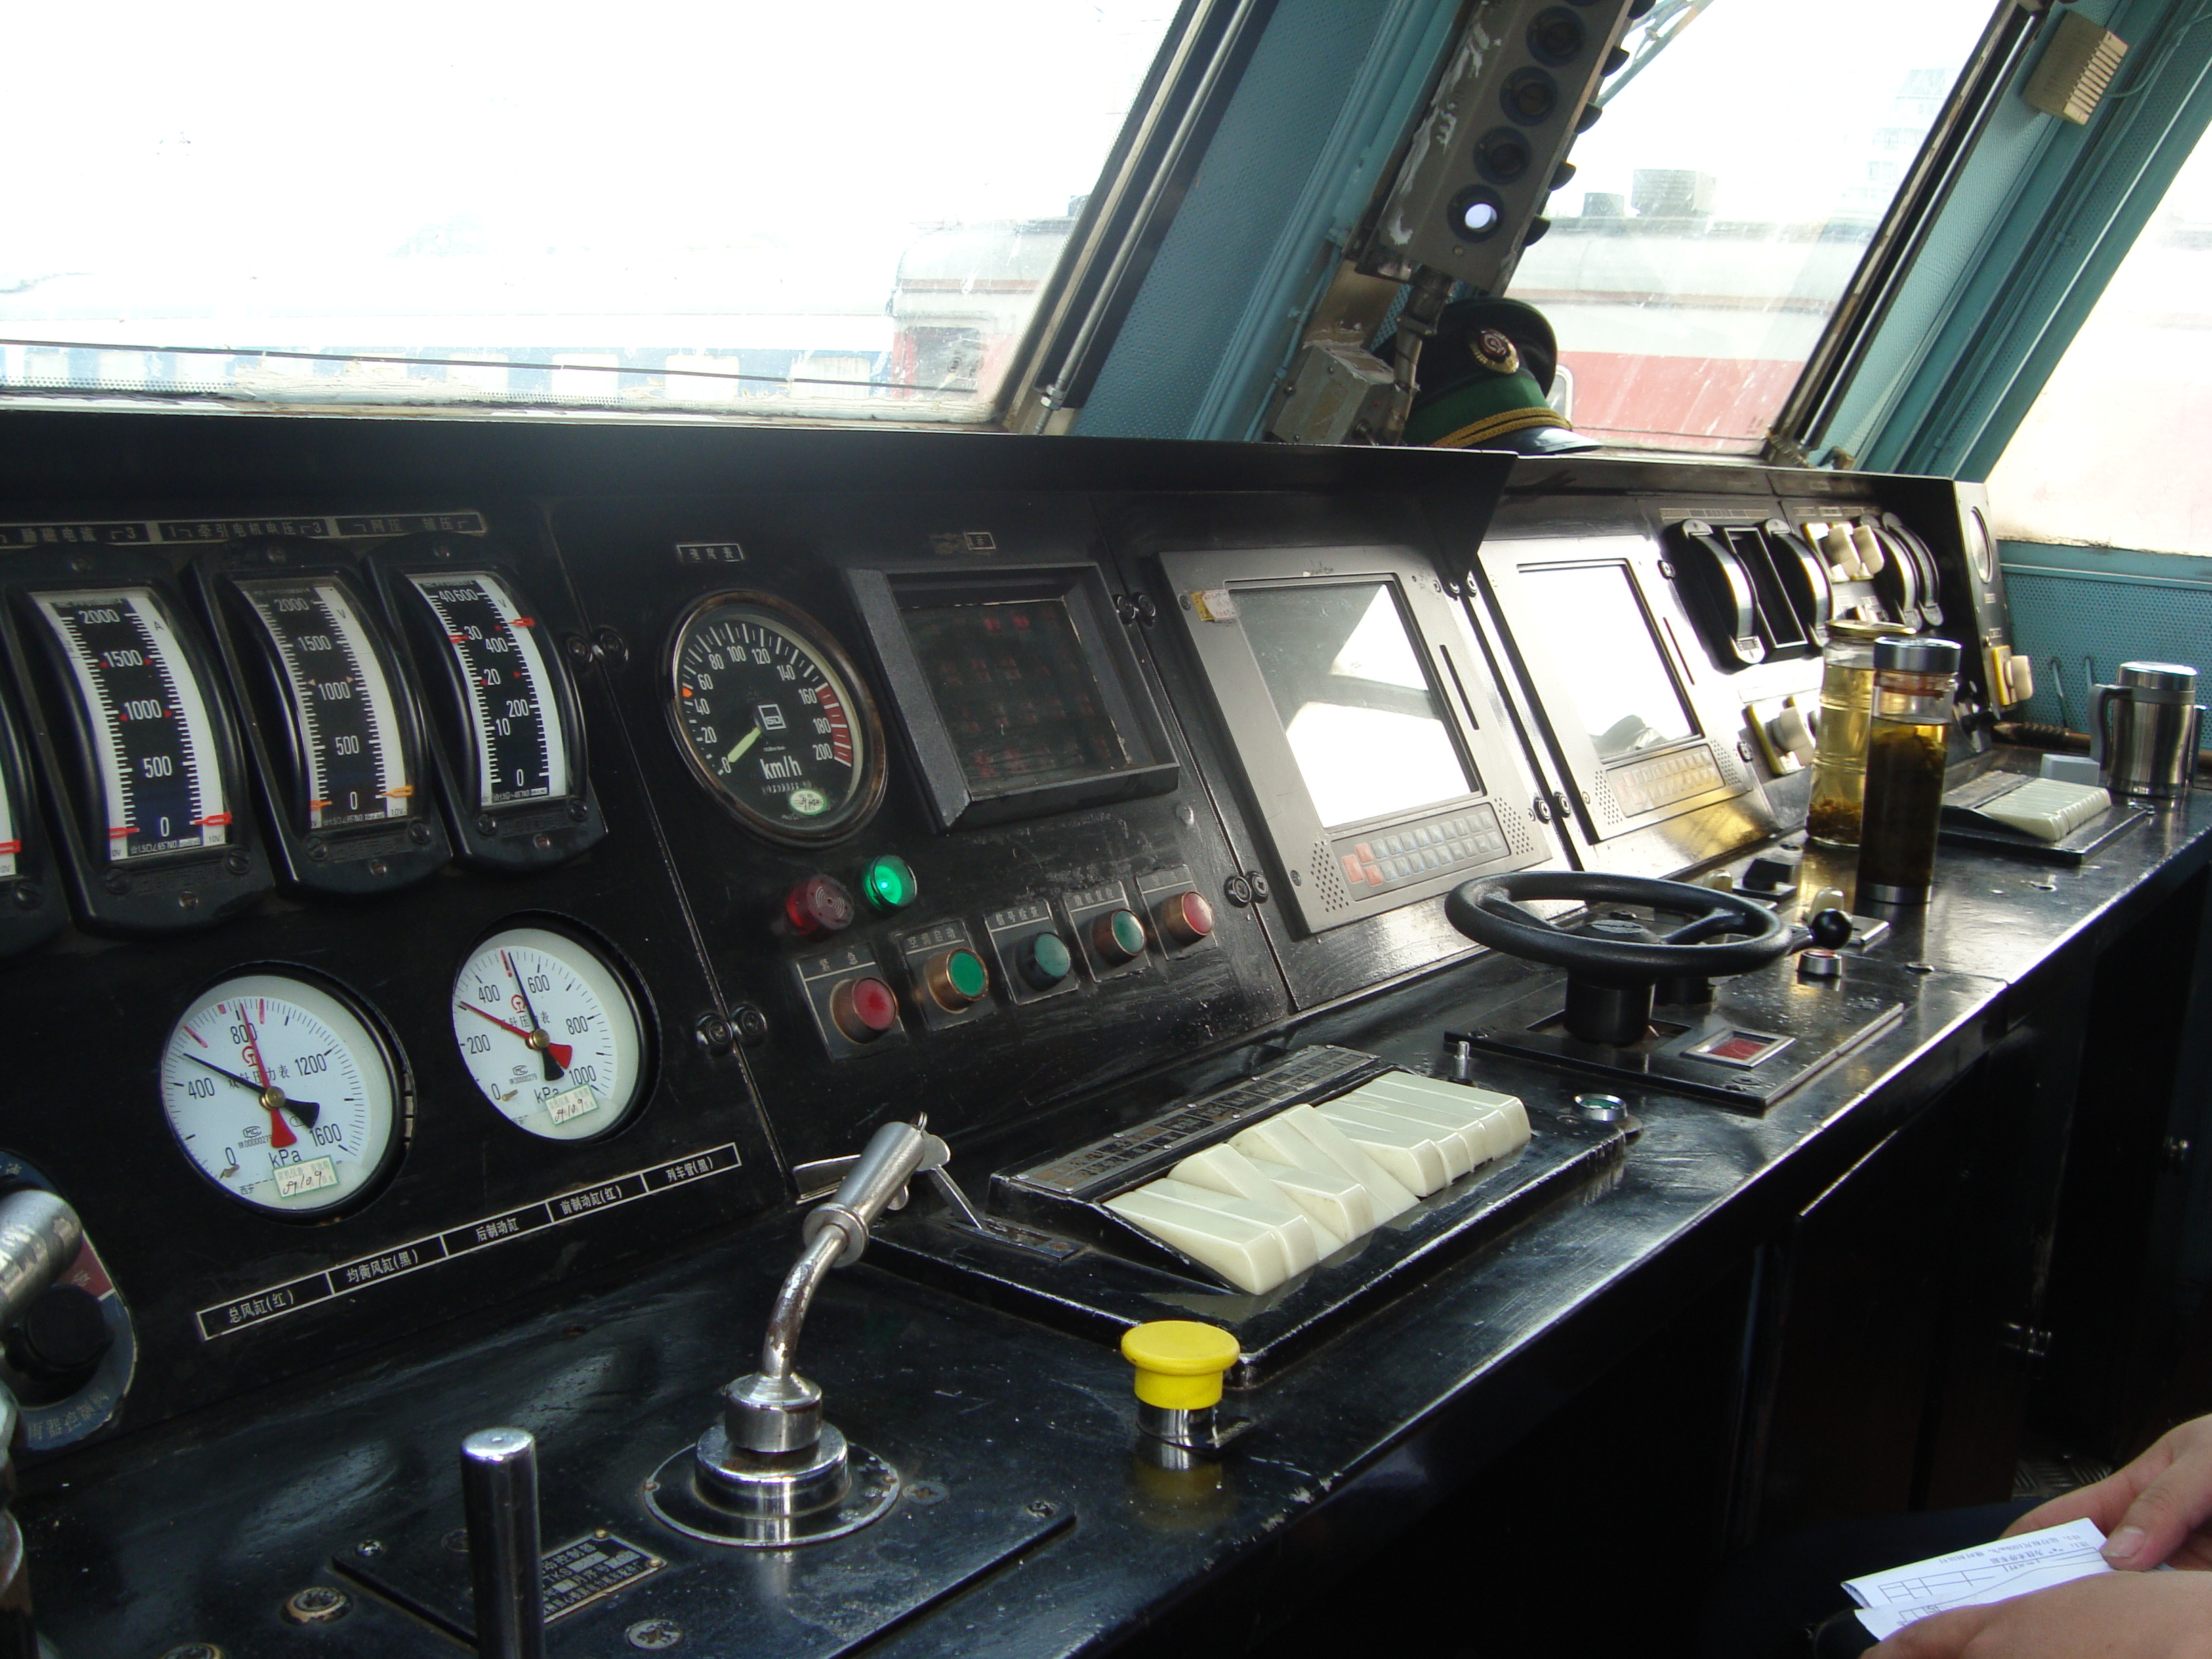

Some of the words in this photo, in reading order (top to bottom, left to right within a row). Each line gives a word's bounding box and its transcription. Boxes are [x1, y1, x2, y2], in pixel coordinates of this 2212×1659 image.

[438, 590, 456, 602] 40
[454, 589, 478, 602] 600
[274, 598, 310, 612] 2000
[78, 609, 121, 623] 2000
[464, 626, 483, 640] 30
[298, 635, 332, 651] 1500
[486, 637, 508, 653] 400
[104, 649, 143, 668] 1500
[709, 653, 724, 670] 80
[726, 646, 746, 663] 100
[752, 648, 771, 665] 120
[484, 668, 500, 686] 20
[777, 664, 796, 681] 140
[318, 681, 351, 700] 1000
[697, 674, 714, 691] 60
[798, 688, 817, 705] 160
[124, 699, 162, 720] 1000
[506, 699, 529, 718] 200
[694, 698, 710, 715] 40
[495, 718, 511, 737] 10
[701, 726, 717, 743] 20
[813, 717, 832, 734] 180
[335, 735, 359, 756] 500
[813, 743, 833, 761] 200
[142, 756, 172, 778] 500
[721, 756, 731, 774] 0
[760, 756, 802, 779] km/h
[516, 769, 524, 787] 0
[350, 791, 358, 810] 0
[160, 817, 169, 837] 0
[528, 975, 550, 994] 600
[478, 985, 500, 1003] 400
[230, 1023, 258, 1045] 800
[566, 1016, 588, 1034] 800
[467, 1034, 491, 1054] 200
[294, 1053, 327, 1077] 1200
[569, 1065, 596, 1086] 1000
[188, 1077, 215, 1100] 400
[491, 1084, 500, 1100] 0
[309, 1123, 342, 1147] 1600
[225, 1147, 237, 1166] 0
[268, 1149, 302, 1168] kPa
[228, 1289, 294, 1323] 总风缸(红)
[346, 1249, 418, 1283] 均衡风缸(黑)
[476, 1218, 519, 1242] 后制动缸
[560, 1185, 623, 1215] 前制动缸(红)
[665, 1156, 714, 1183] 列车管(黑)
